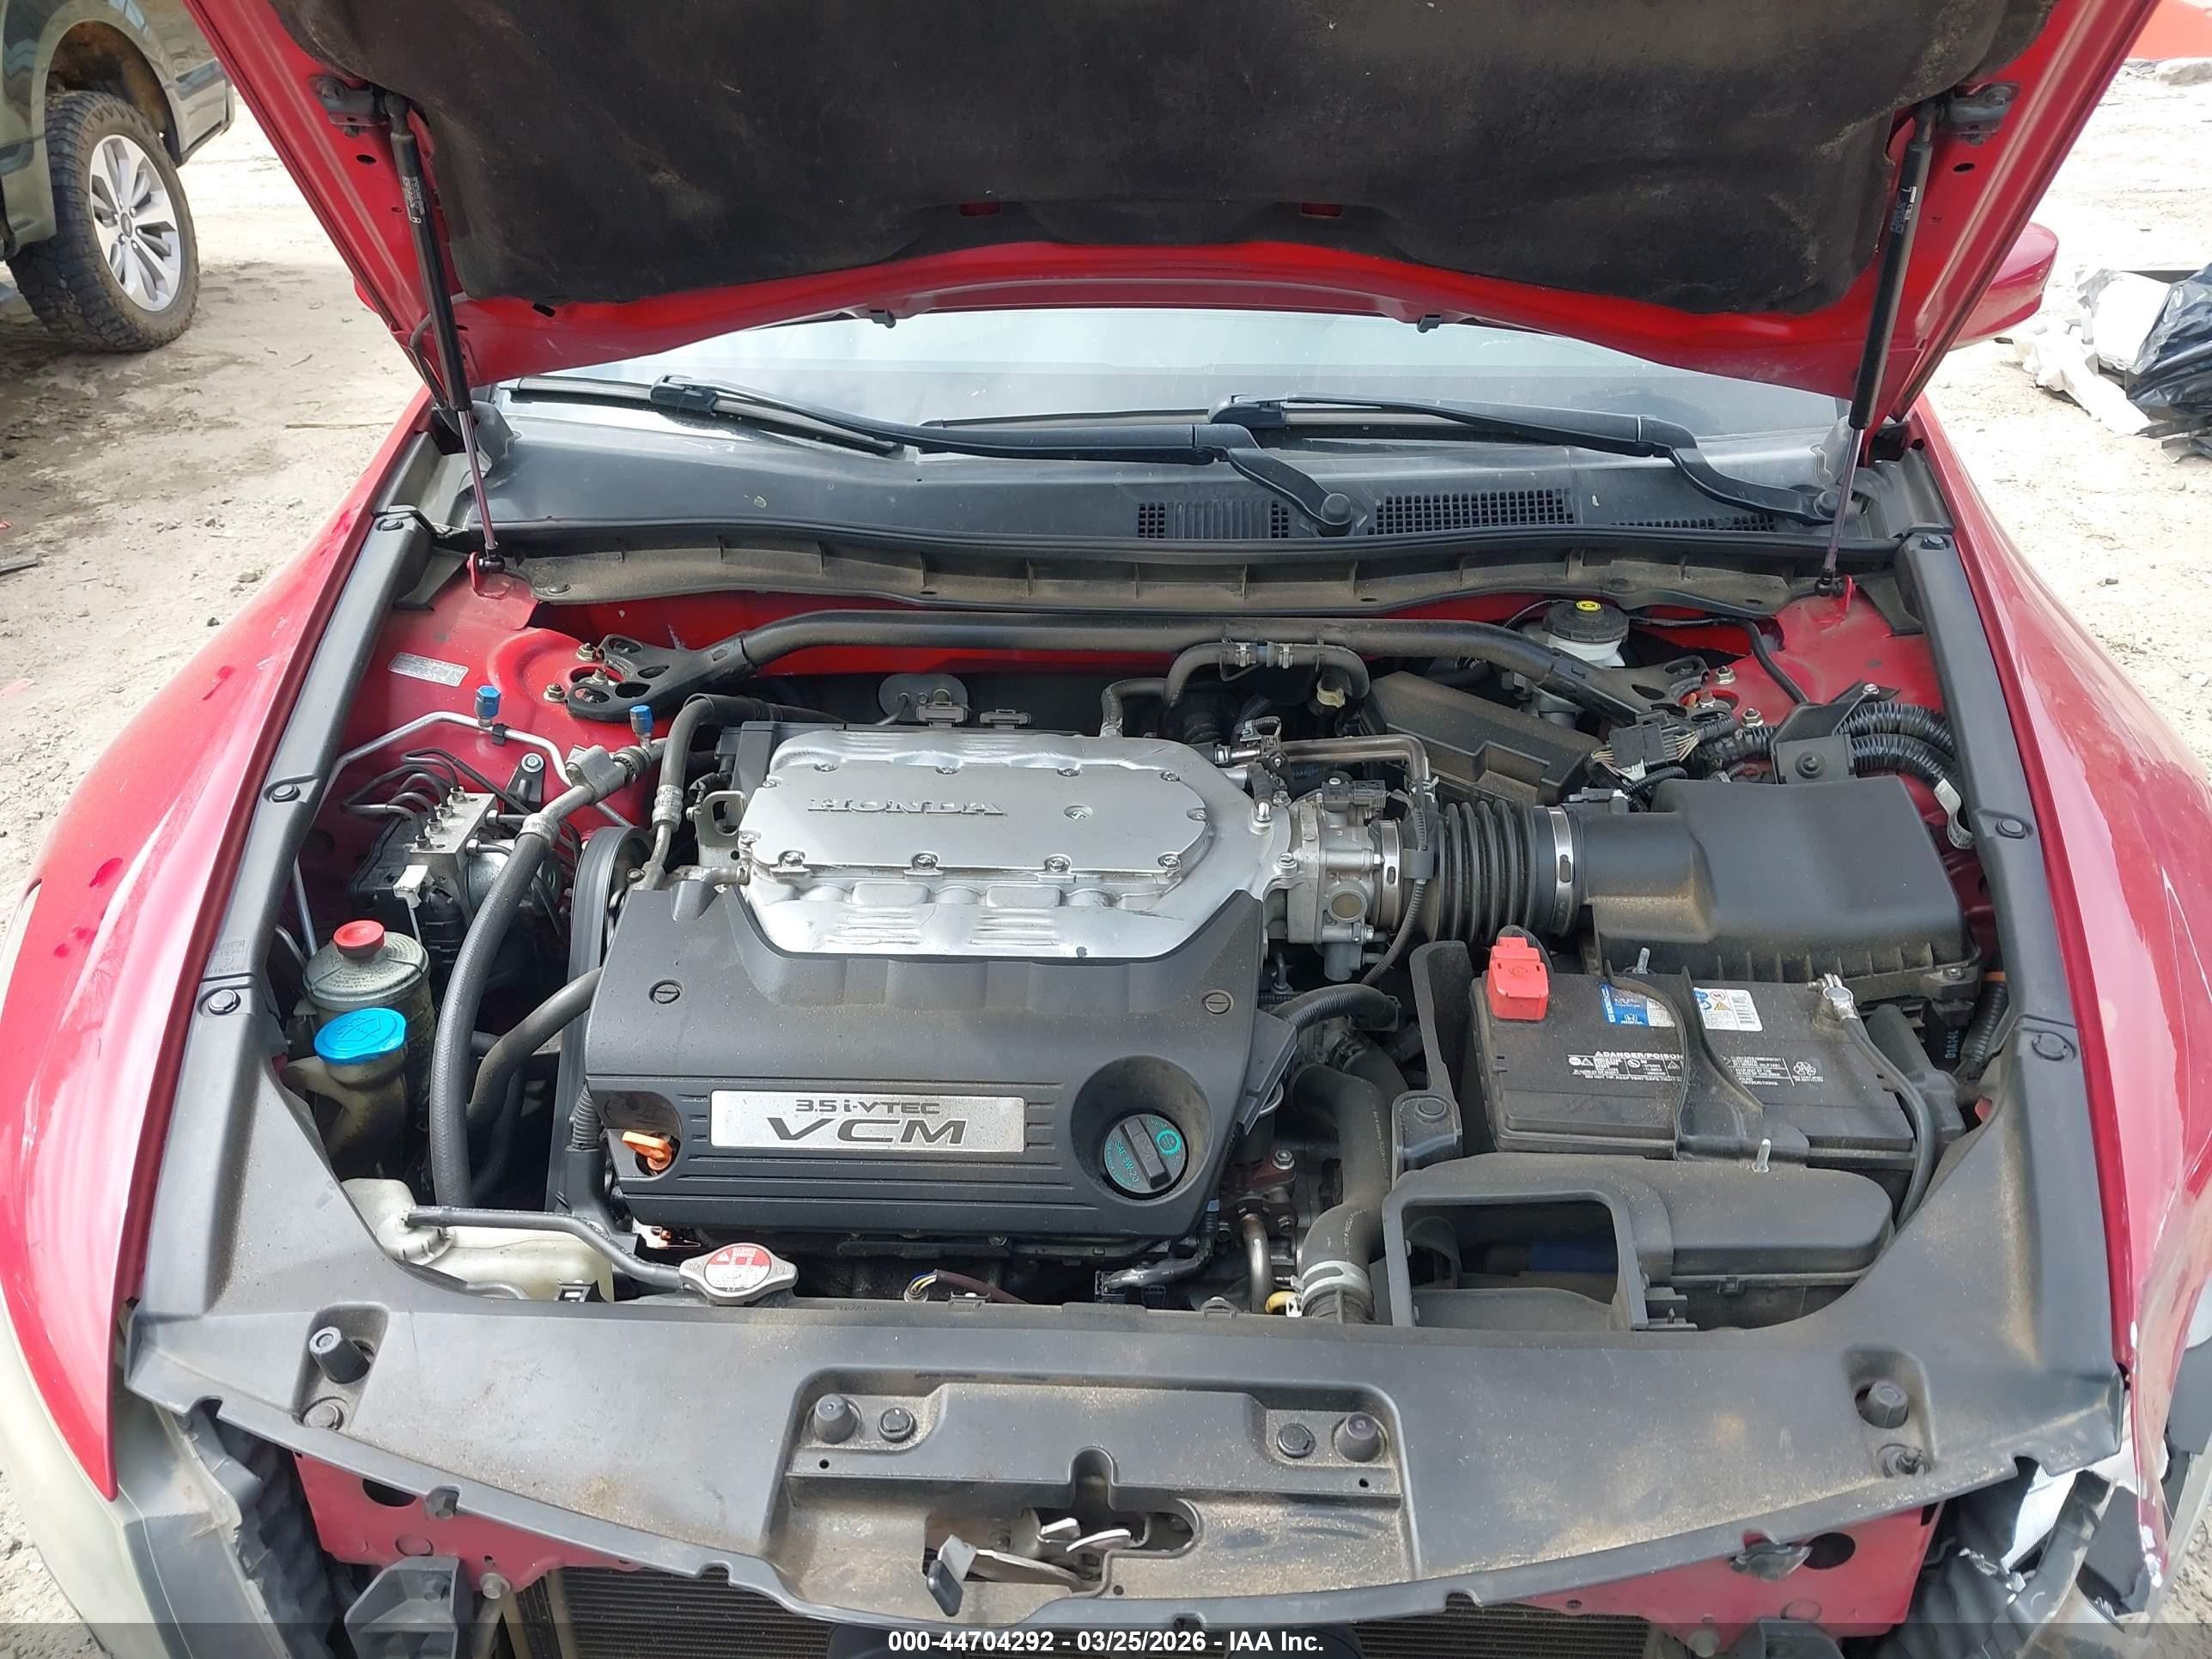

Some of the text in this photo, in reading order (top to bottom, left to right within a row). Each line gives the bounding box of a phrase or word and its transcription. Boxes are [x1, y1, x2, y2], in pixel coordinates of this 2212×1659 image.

[807, 798, 1008, 817] HONDA
[796, 1099, 940, 1115] 3.5 i-VTEC
[767, 1117, 967, 1145] VCM
[1115, 1140, 1127, 1157] SAE
[1123, 1158, 1139, 1182] 5W-20
